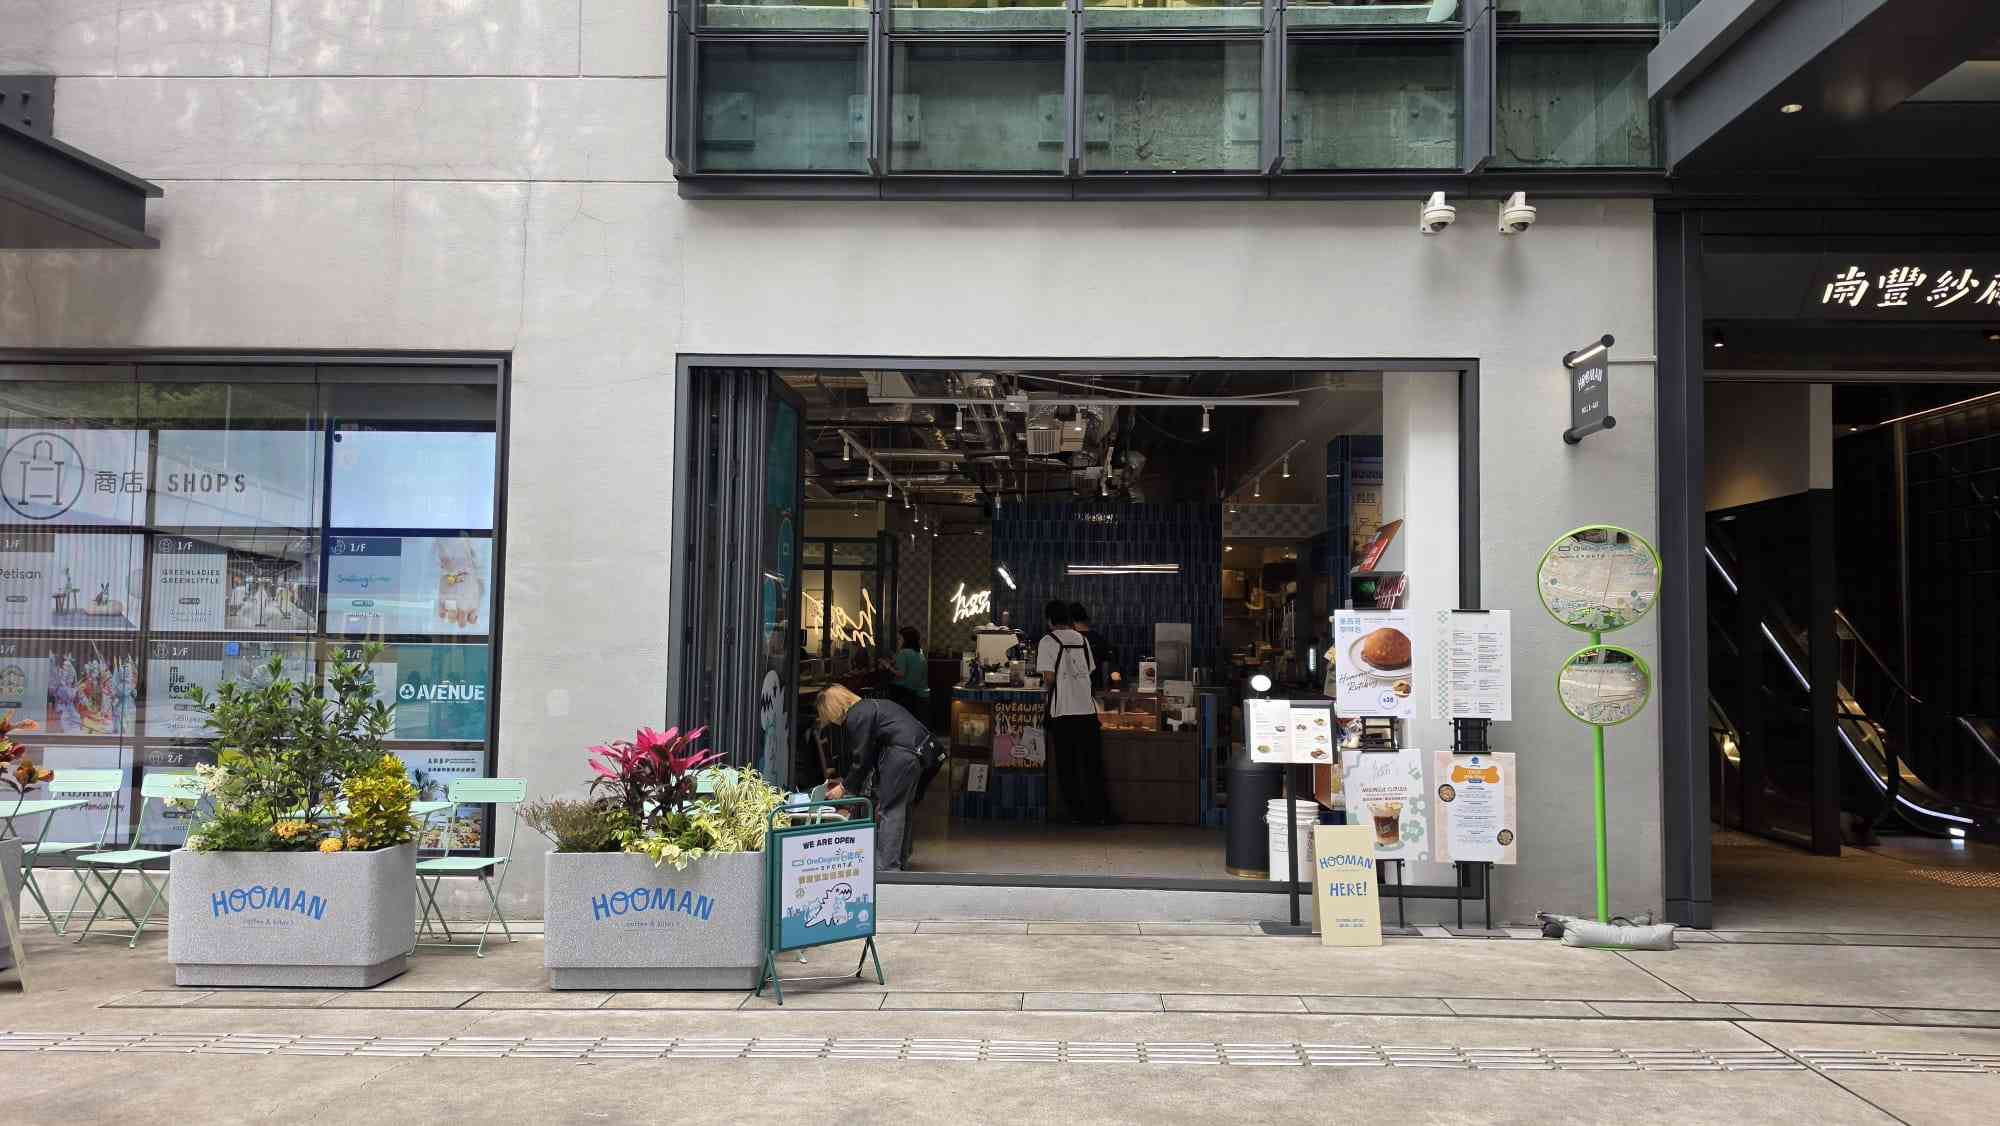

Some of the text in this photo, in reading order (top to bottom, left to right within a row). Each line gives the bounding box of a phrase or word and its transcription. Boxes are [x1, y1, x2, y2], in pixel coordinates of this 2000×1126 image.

[94, 471, 145, 494] 商店
[167, 473, 247, 493] SHOPS
[177, 541, 193, 551] 1/F
[350, 543, 366, 552] 1/F
[173, 647, 189, 656] 1/F
[417, 684, 485, 700] AVENUE
[168, 754, 183, 763] 2/F
[802, 836, 856, 850] WE ARE OPEN
[1319, 854, 1374, 870] HOOMAN
[1330, 881, 1367, 897] HERE!
[211, 885, 328, 920] HOOMAN
[591, 887, 715, 921] HOOMAN
